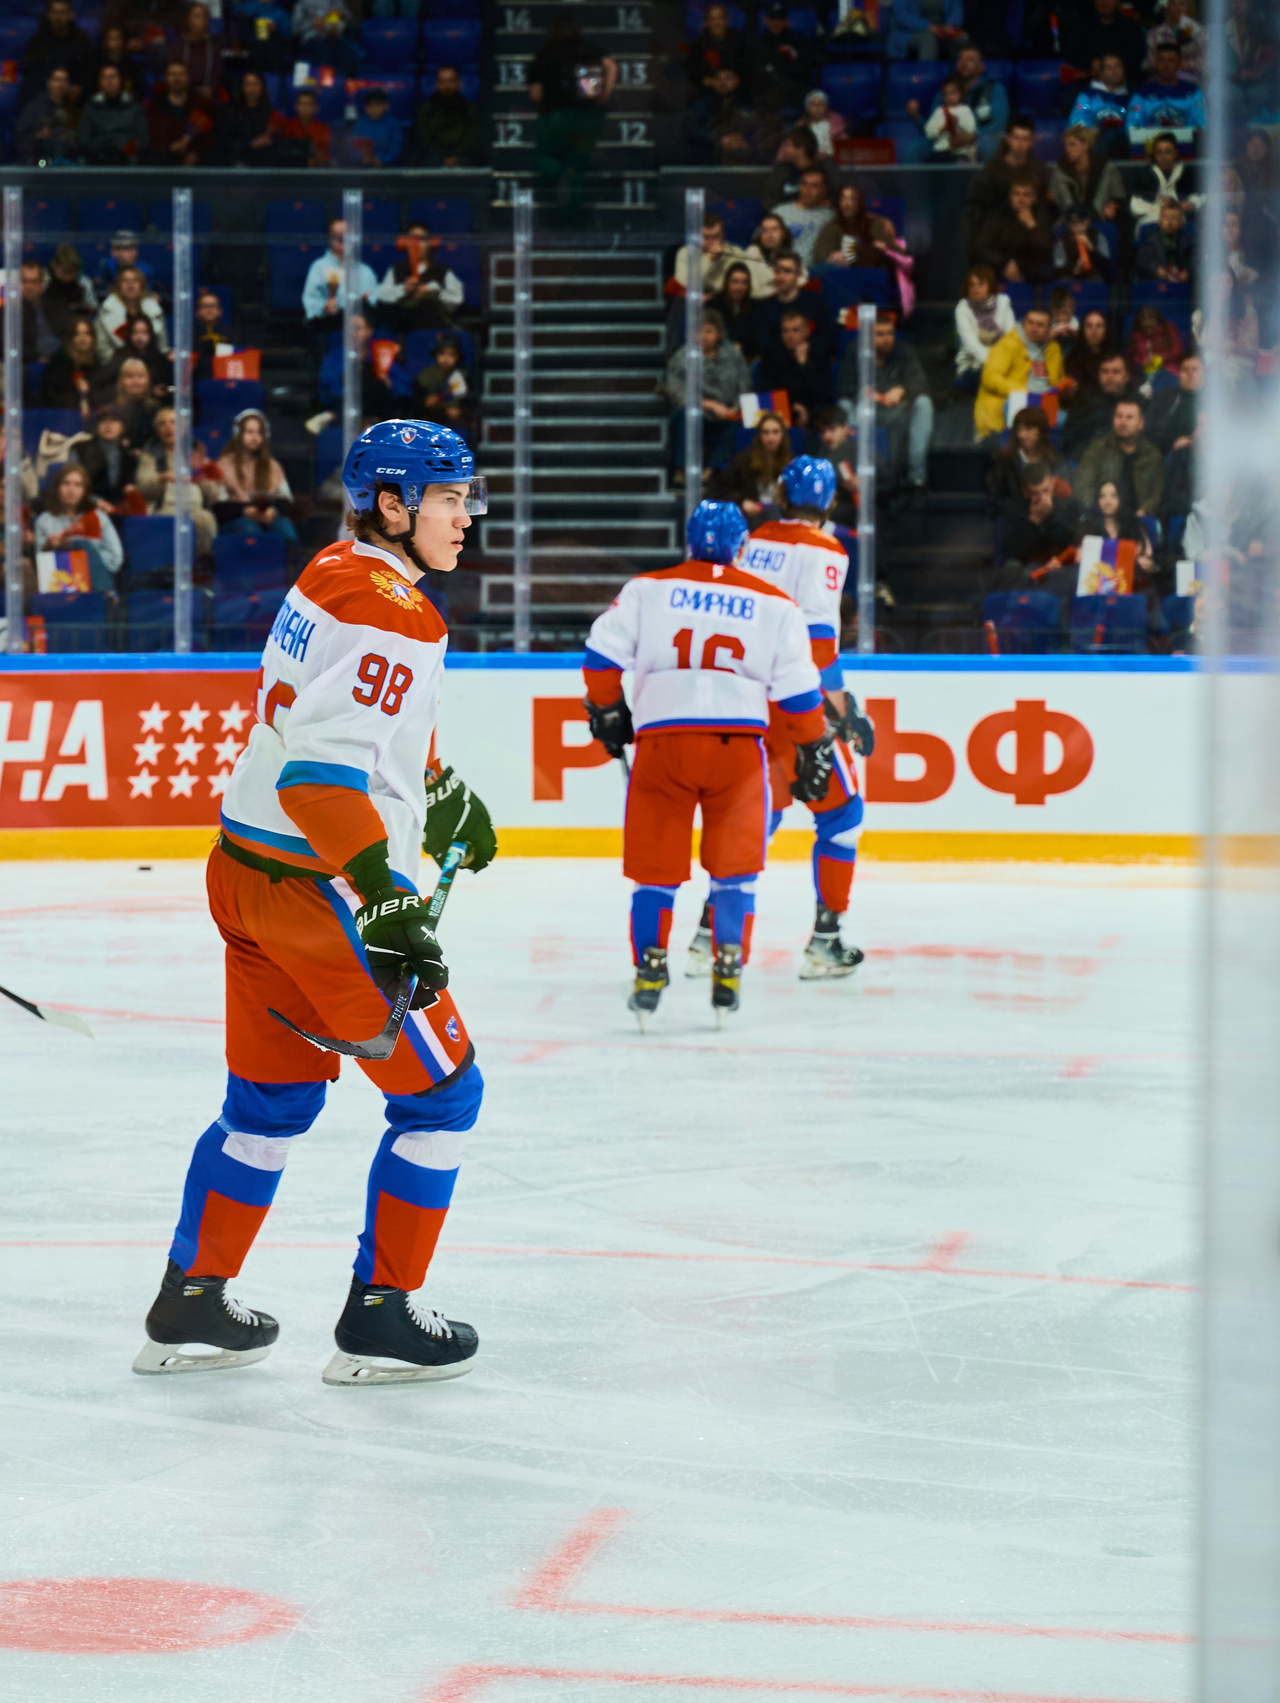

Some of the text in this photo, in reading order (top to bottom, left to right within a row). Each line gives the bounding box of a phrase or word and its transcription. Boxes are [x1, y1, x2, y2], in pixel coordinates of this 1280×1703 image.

[498, 61, 527, 85] 13
[621, 61, 647, 85] 13
[495, 122, 523, 143] 12
[619, 121, 647, 143] 12
[623, 180, 646, 206] 11
[376, 467, 407, 476] CCM
[670, 587, 755, 620] СМИРНОВ
[352, 652, 414, 716] 98
[356, 895, 420, 939] AUER
